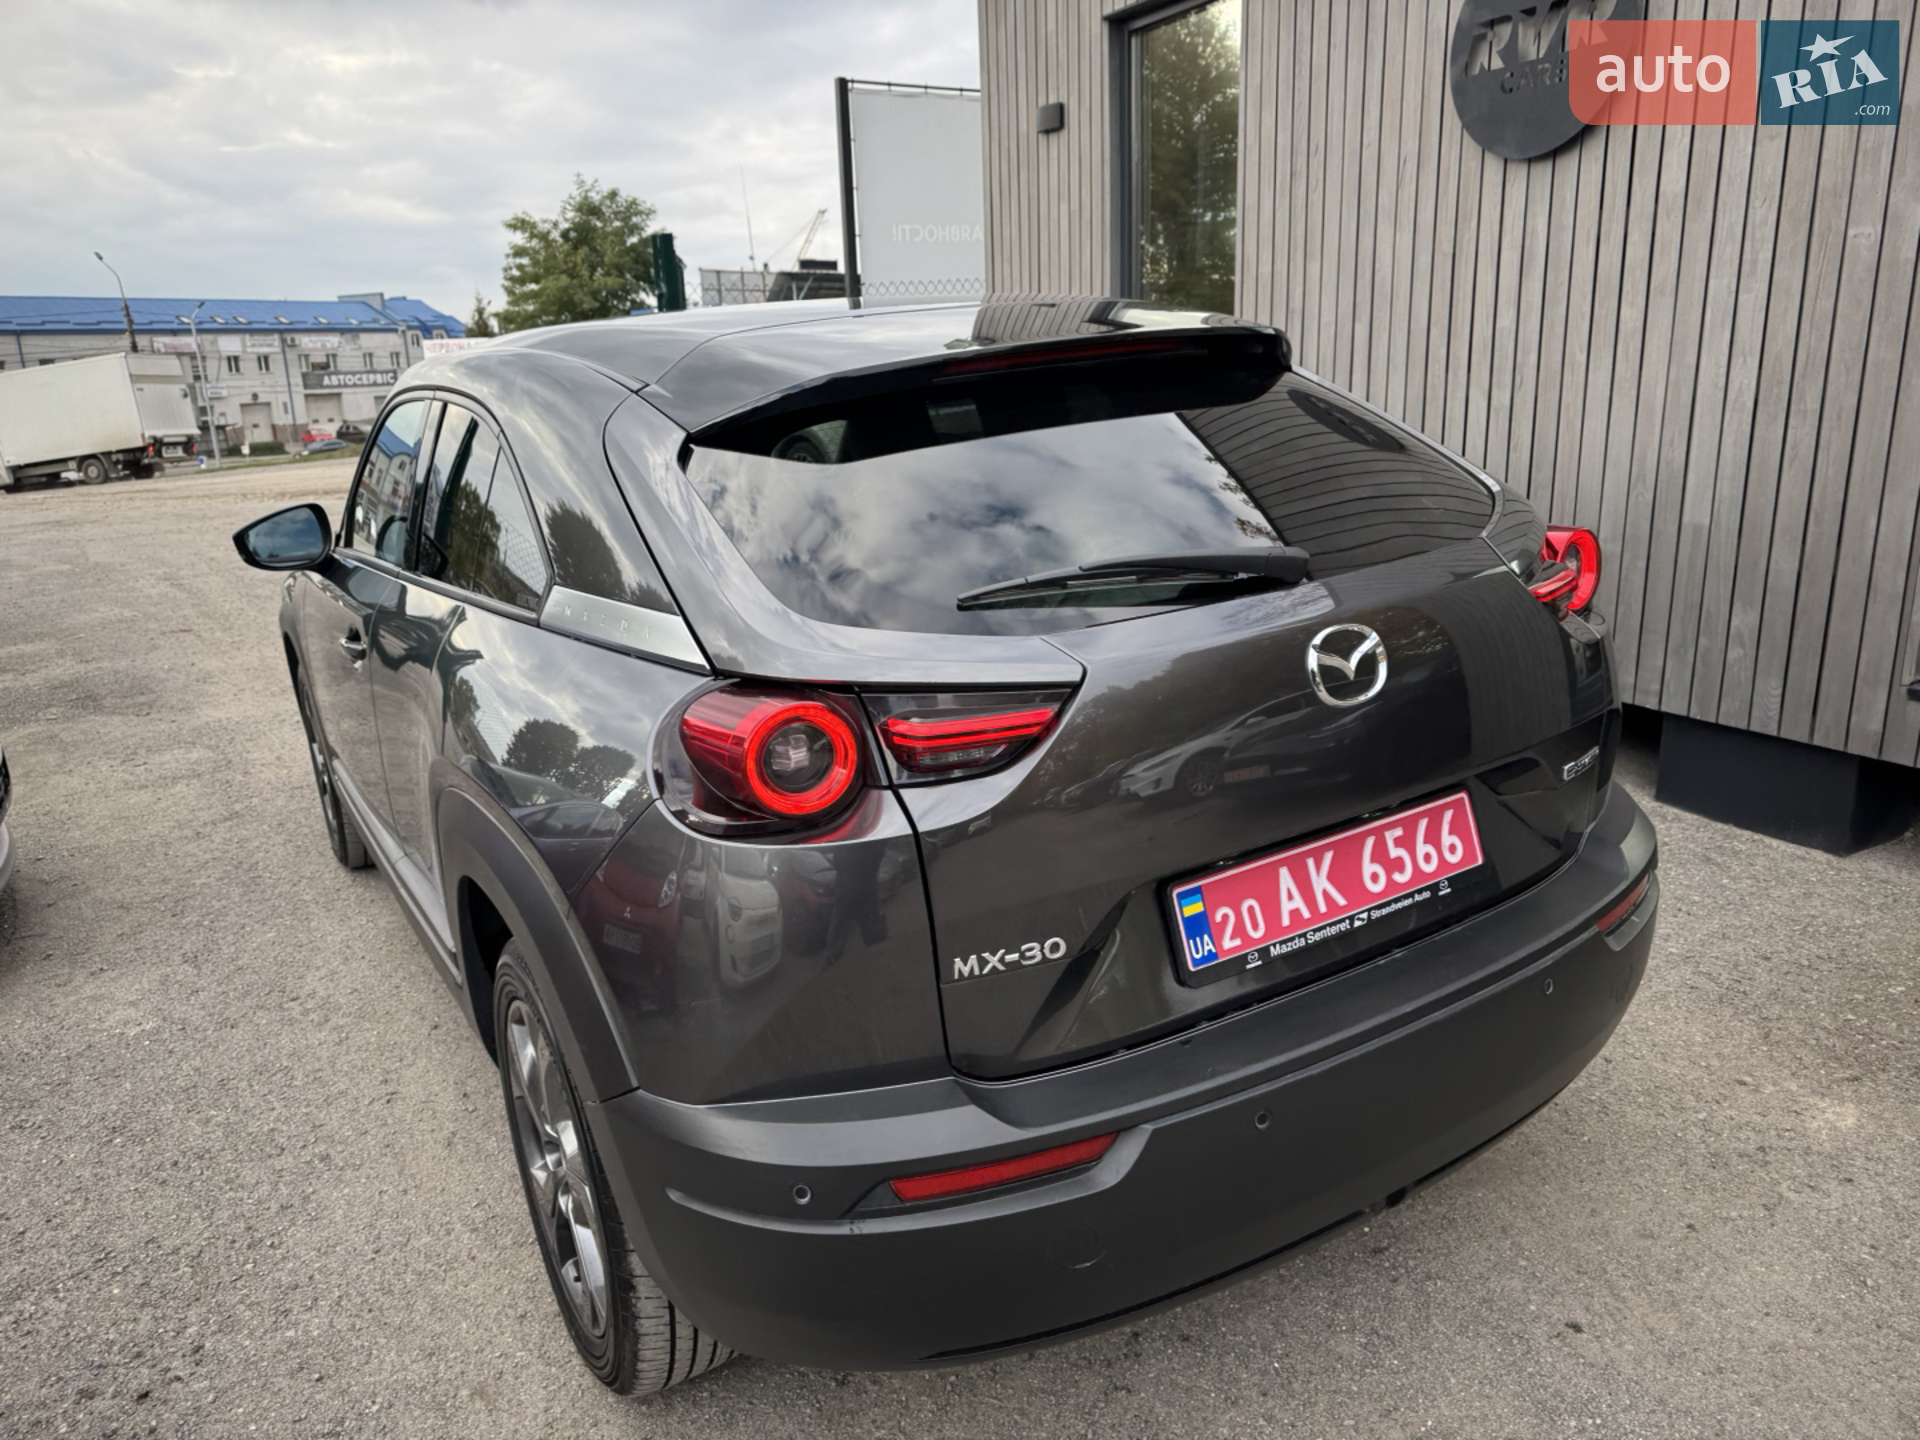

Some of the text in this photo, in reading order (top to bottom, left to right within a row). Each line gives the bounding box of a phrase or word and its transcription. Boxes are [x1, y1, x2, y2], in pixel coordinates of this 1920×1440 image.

[322, 372, 395, 387] АВТОСЕРВІС
[1214, 808, 1464, 950] 20 AK 6566
[1413, 889, 1432, 903] Auto
[1189, 937, 1216, 960] UA
[1269, 919, 1351, 957] Mazda Senteret
[953, 937, 1068, 980] MX-30
